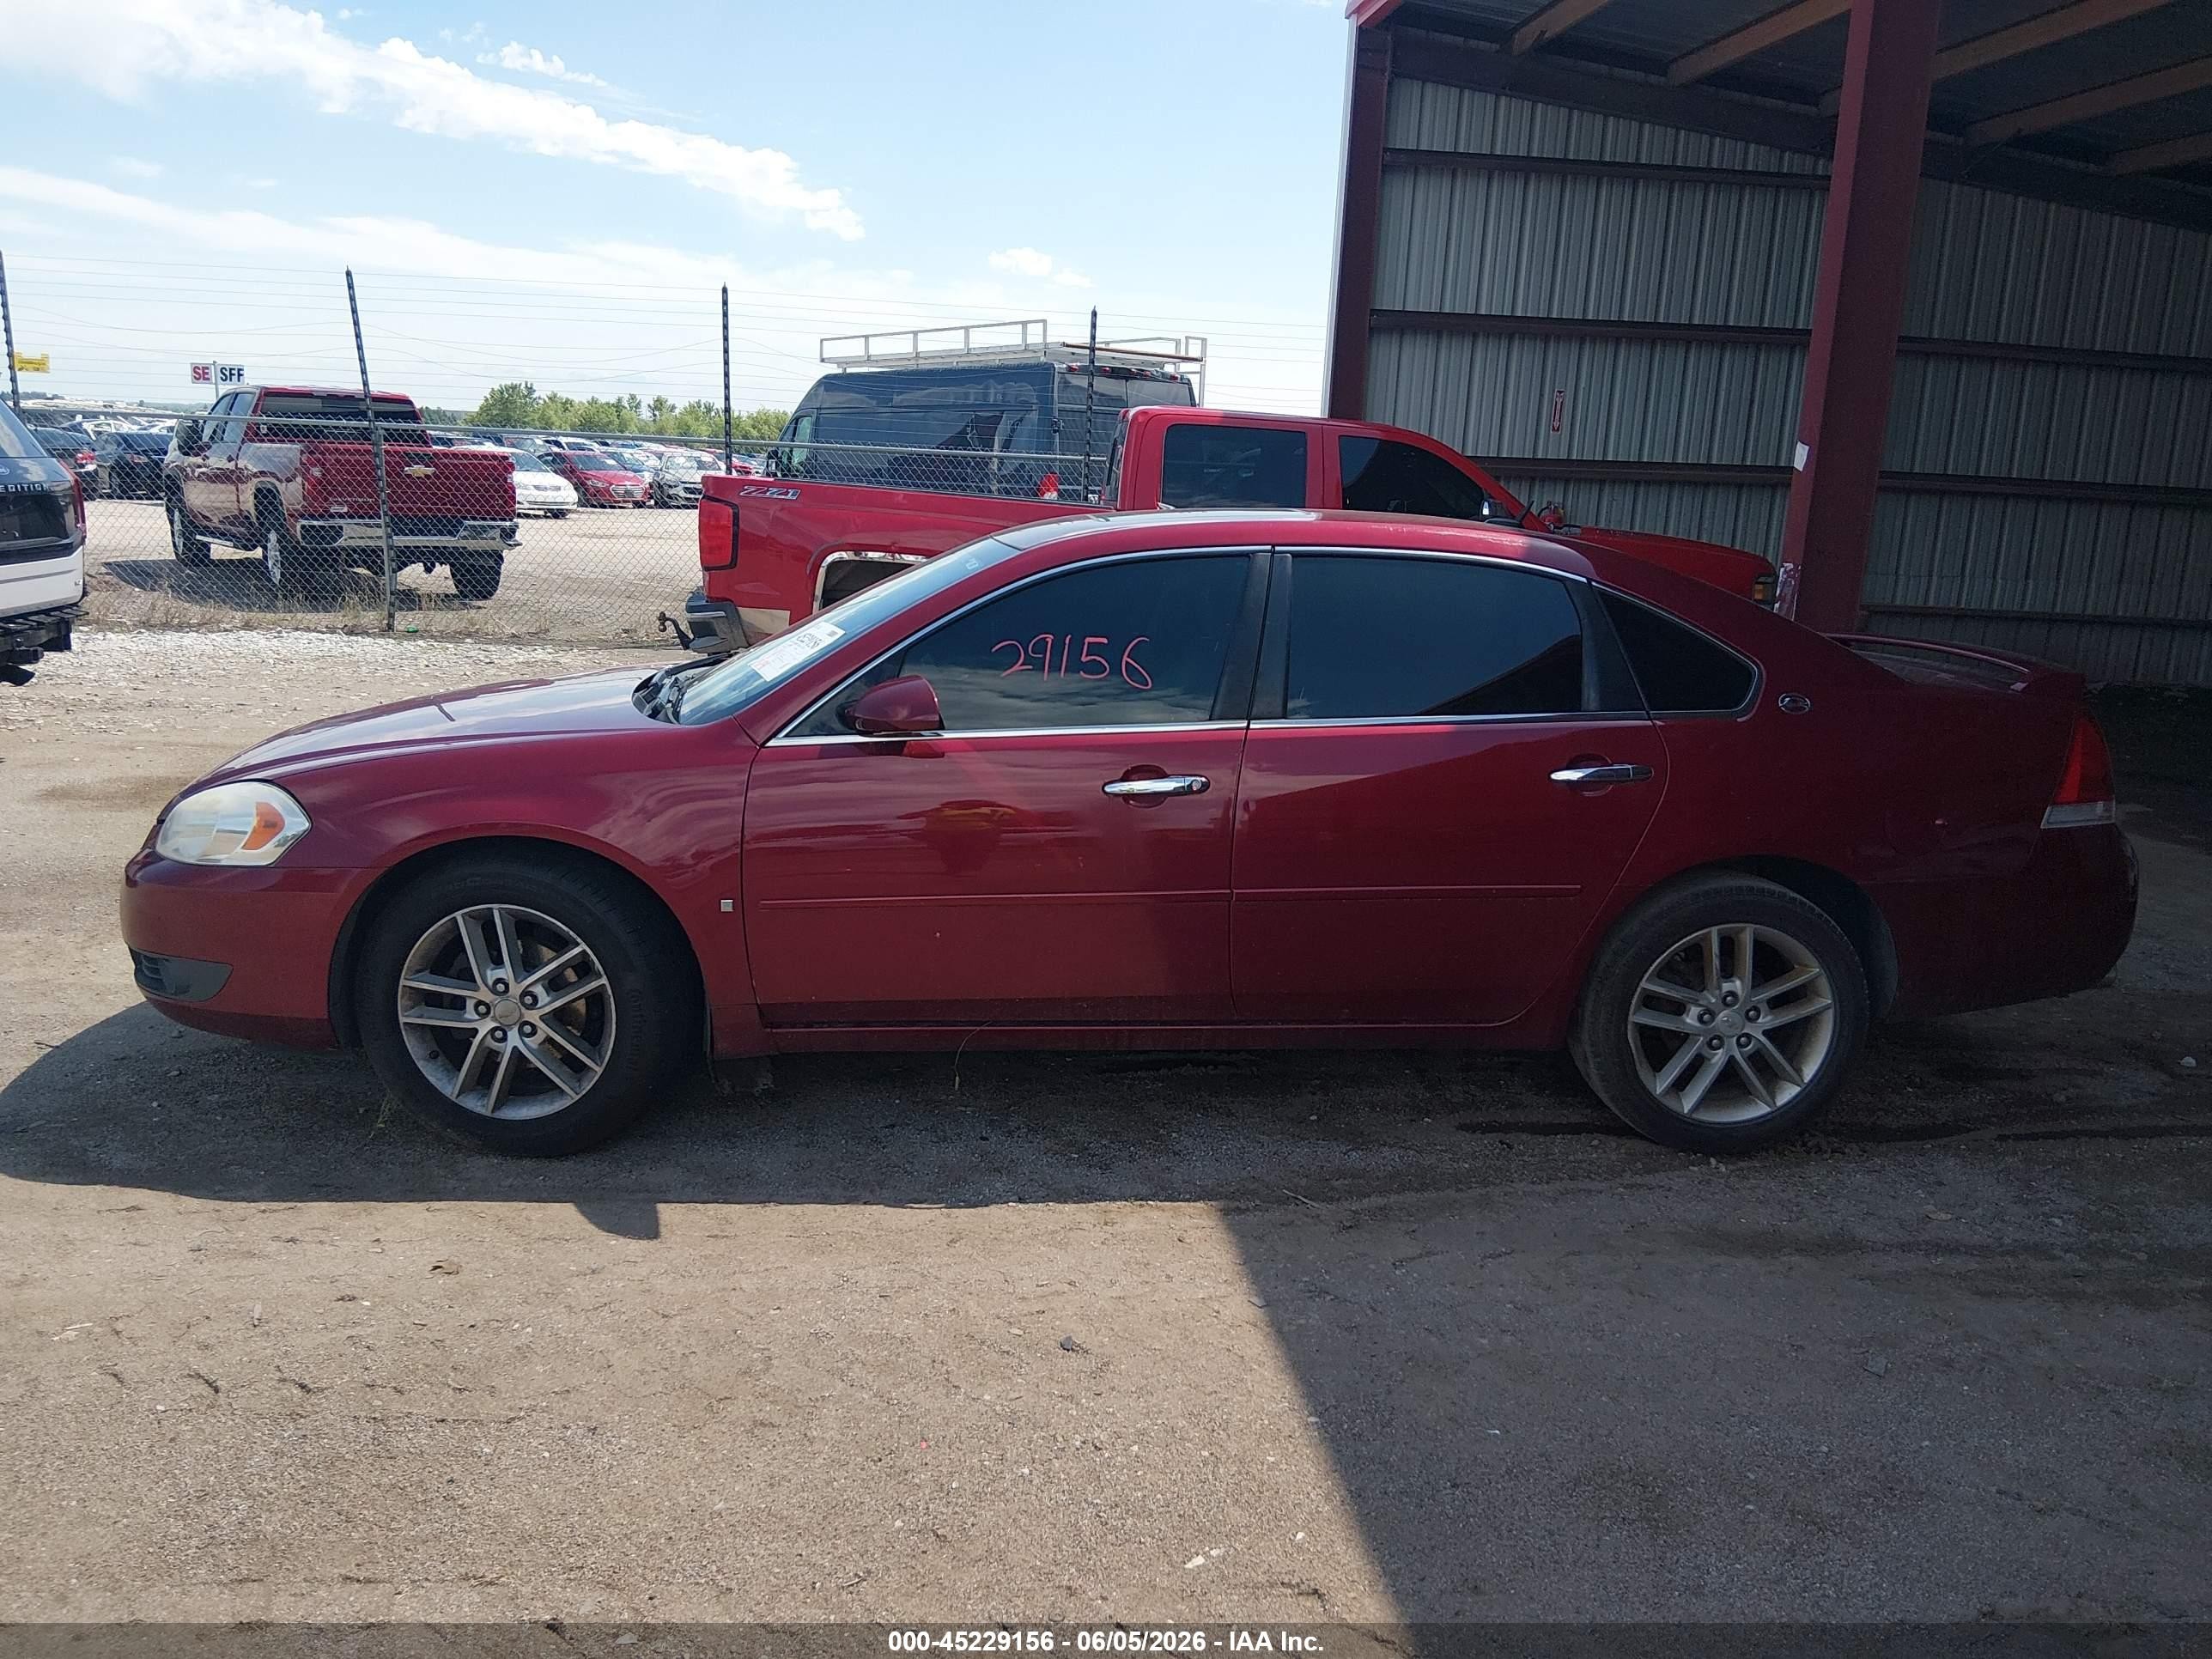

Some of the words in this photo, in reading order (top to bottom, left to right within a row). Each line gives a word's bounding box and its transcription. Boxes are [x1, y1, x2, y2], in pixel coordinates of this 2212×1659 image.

[192, 365, 211, 381] SE
[219, 367, 245, 383] SFF
[739, 485, 801, 500] Z71
[991, 634, 1152, 690] 29156
